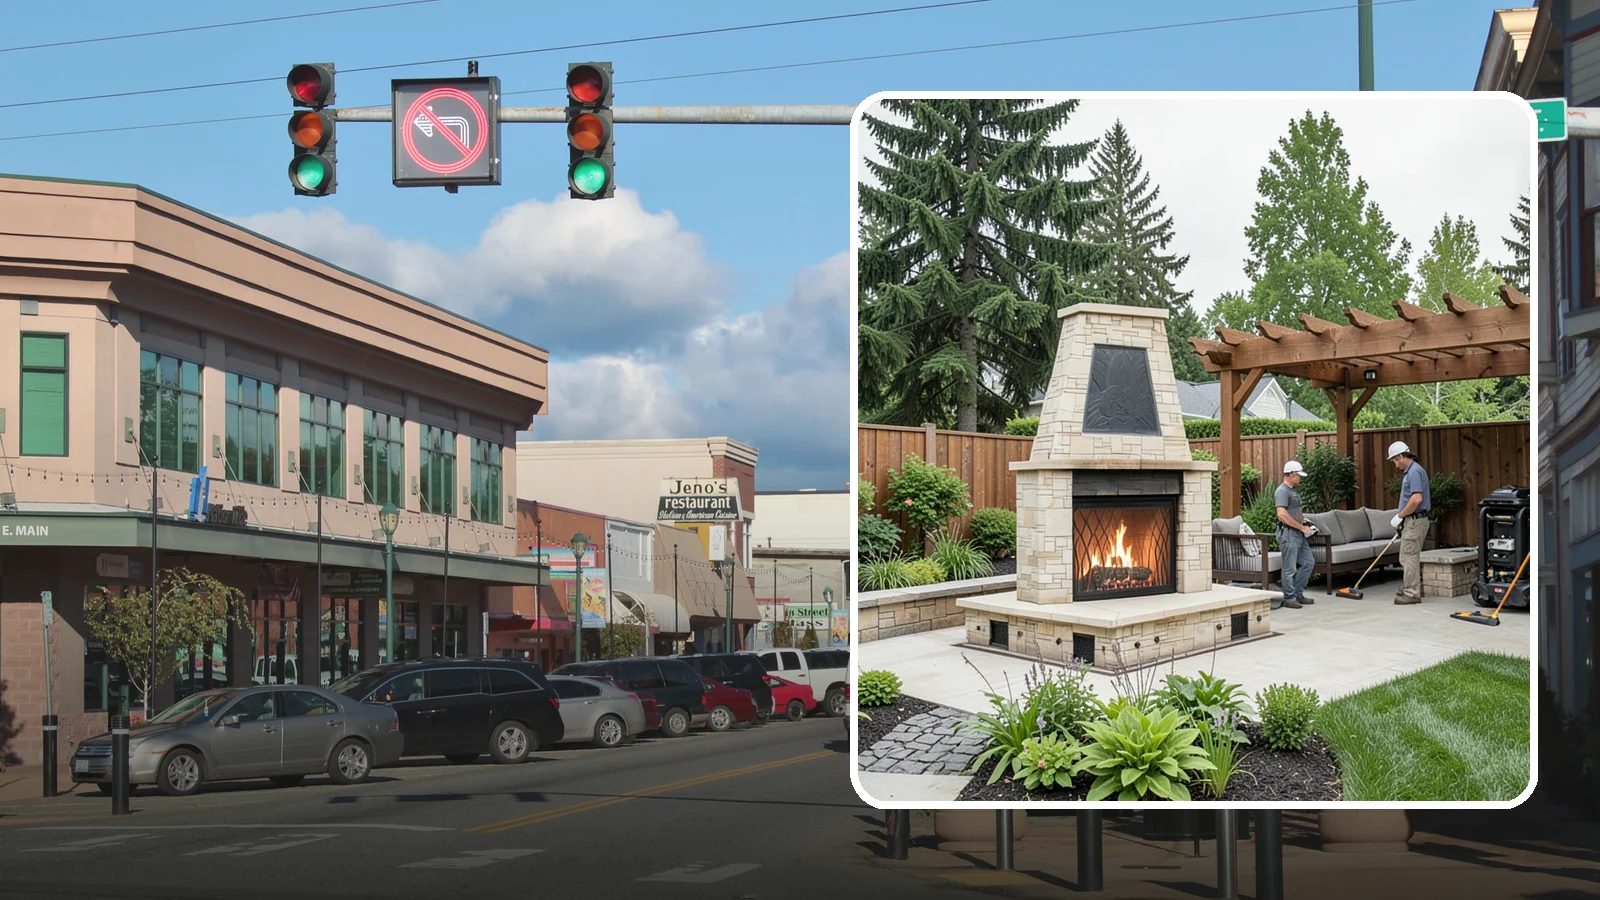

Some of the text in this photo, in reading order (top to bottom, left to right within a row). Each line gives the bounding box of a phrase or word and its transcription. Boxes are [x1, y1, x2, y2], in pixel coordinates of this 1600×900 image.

[670, 480, 727, 494] Jeno's
[665, 496, 731, 509] restaurant
[686, 509, 714, 519] American
[715, 509, 737, 519] Cuisine
[2, 525, 49, 536] E. MAIN
[797, 607, 828, 616] Street
